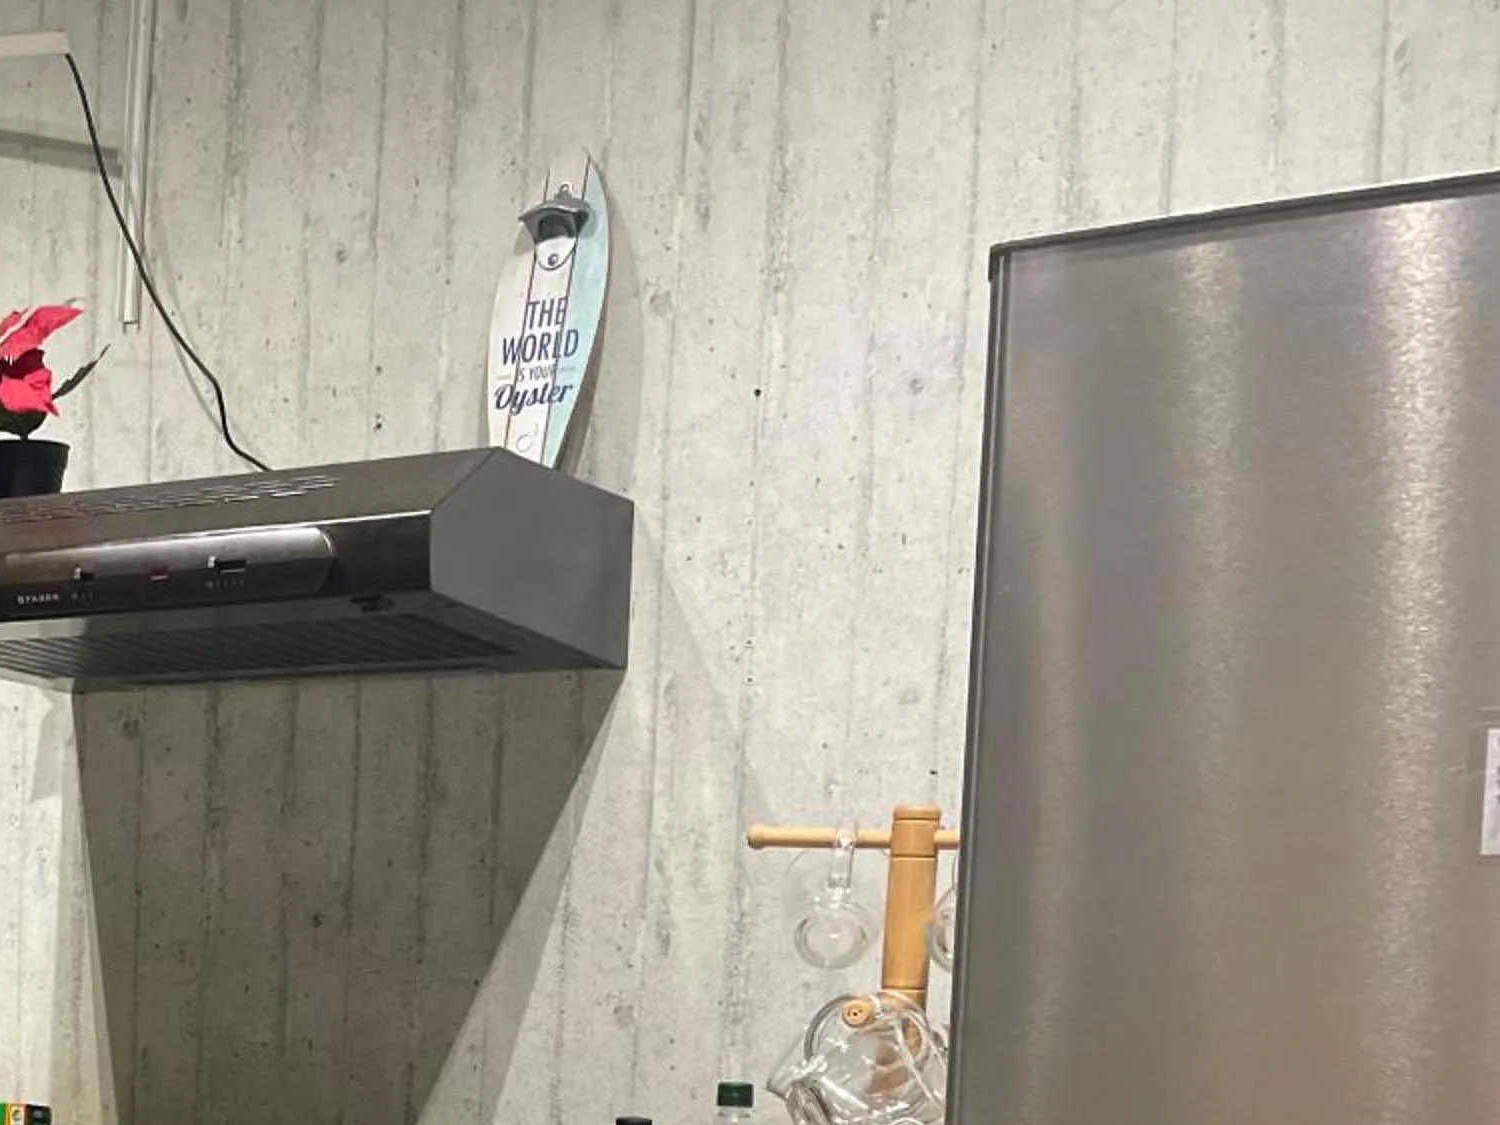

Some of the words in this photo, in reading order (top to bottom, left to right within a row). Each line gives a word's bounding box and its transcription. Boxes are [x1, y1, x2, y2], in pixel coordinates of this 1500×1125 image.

[527, 297, 568, 330] THE
[503, 328, 579, 366] WORLD
[494, 382, 574, 416] Oyster
